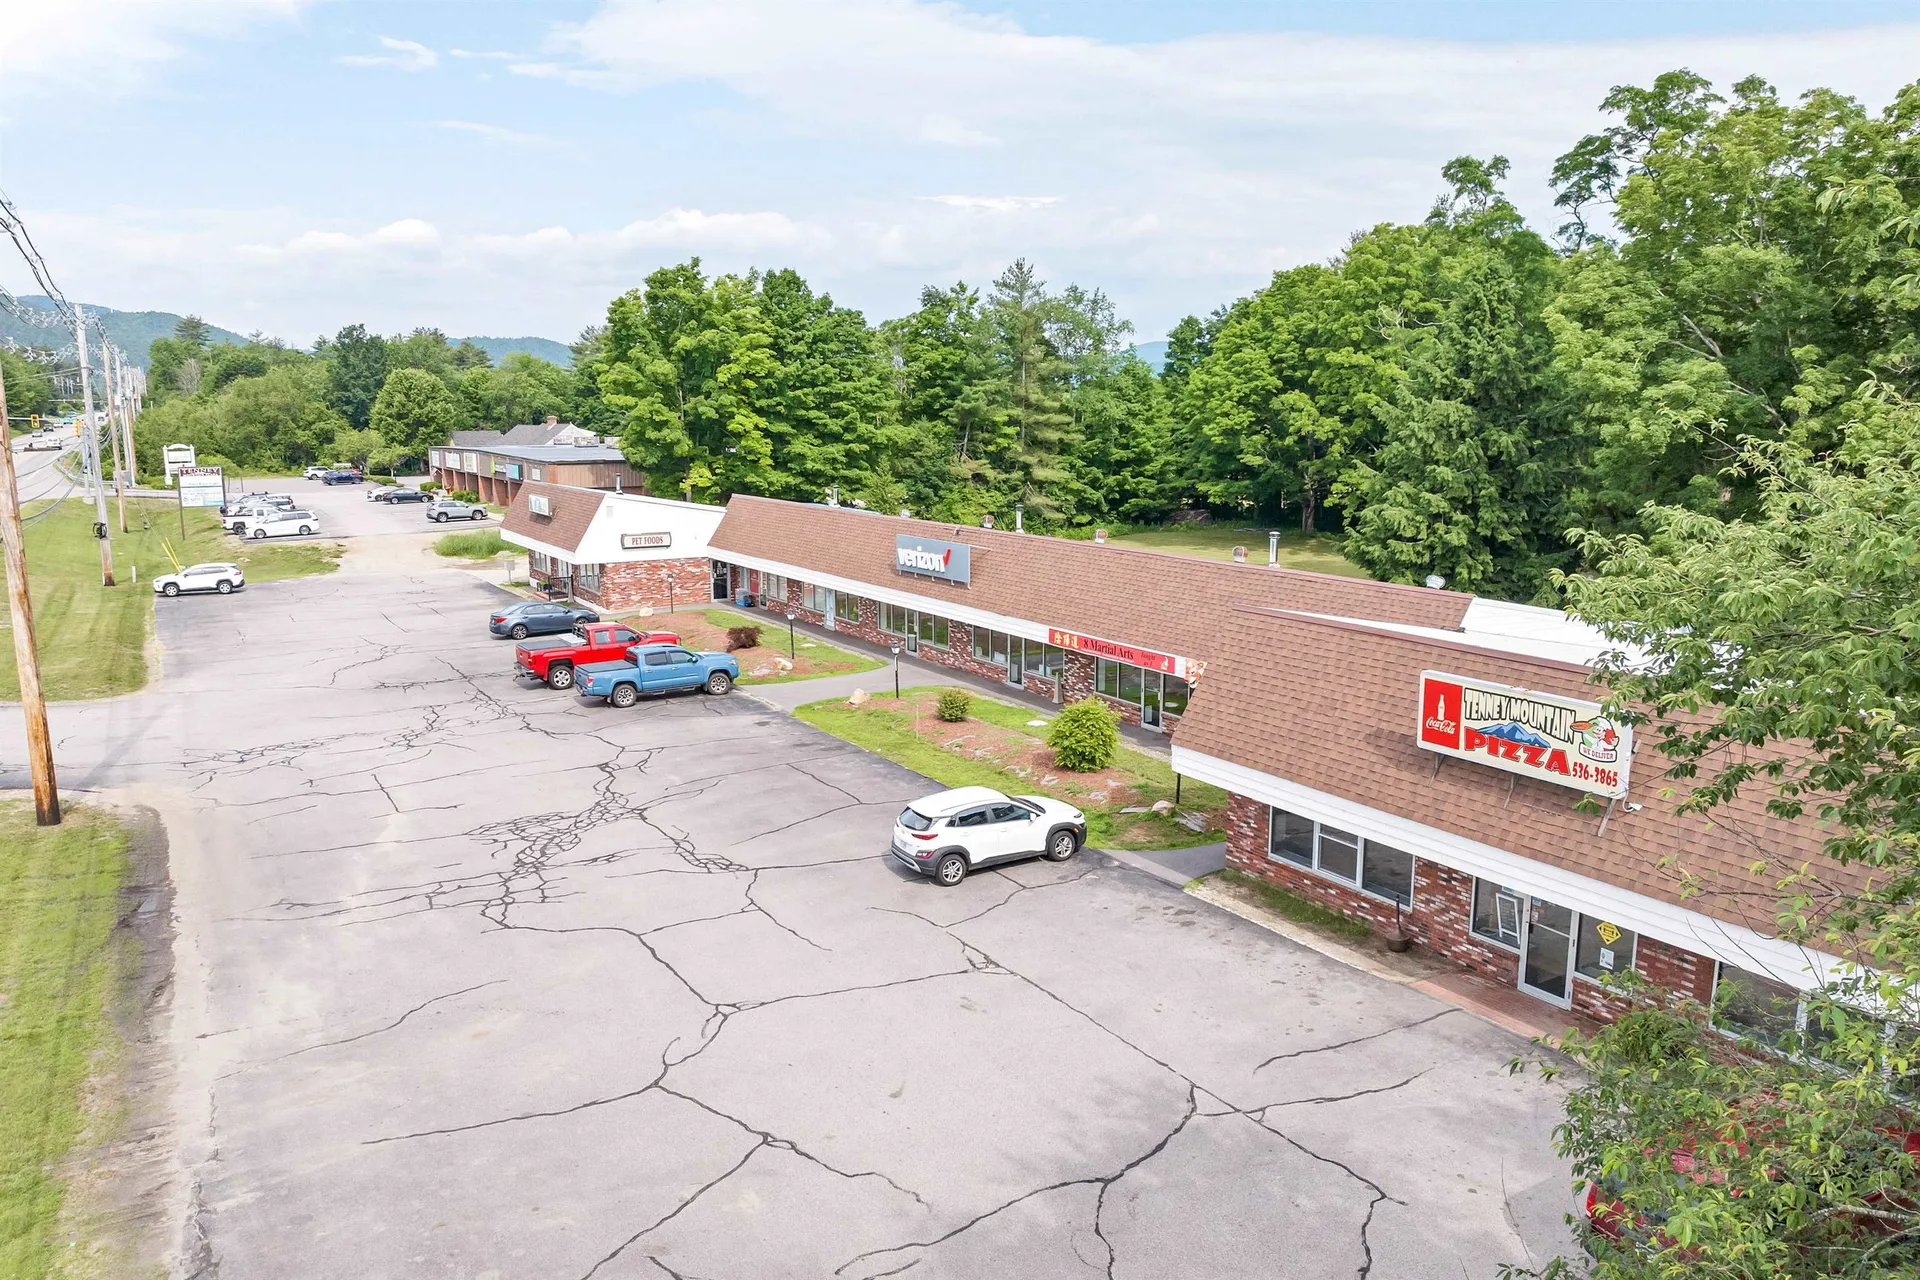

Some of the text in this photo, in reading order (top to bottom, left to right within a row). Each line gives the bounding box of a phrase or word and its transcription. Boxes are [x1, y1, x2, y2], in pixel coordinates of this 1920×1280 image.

[631, 536, 664, 545] PET FOODS
[897, 546, 946, 573] verizon
[1083, 639, 1089, 649] 8
[1090, 639, 1117, 656] Martial
[1118, 647, 1134, 660] Arts
[1464, 687, 1577, 744] TENNEY MOUNTAIN
[1464, 726, 1572, 777] PIZZA
[1582, 746, 1615, 760] WE DELIVER
[1572, 761, 1619, 788] 536-3865
